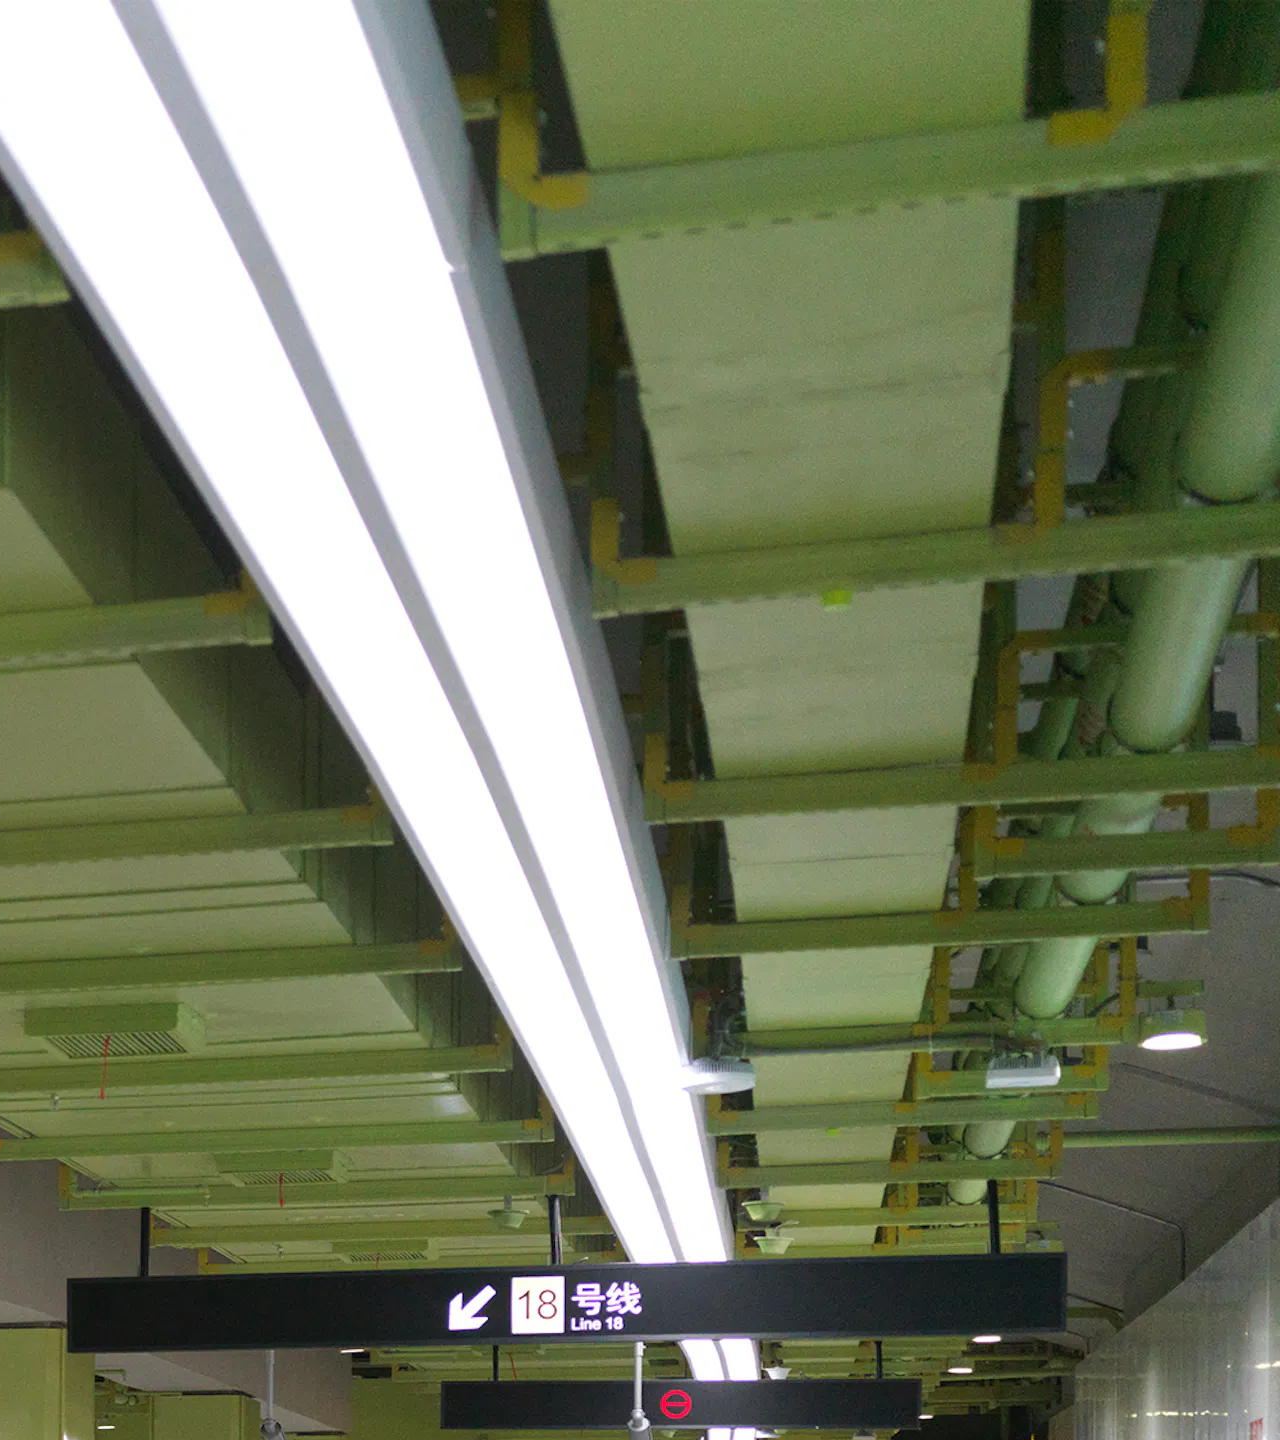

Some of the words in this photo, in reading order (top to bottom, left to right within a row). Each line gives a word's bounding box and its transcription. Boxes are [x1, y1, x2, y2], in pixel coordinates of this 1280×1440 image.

[518, 1289, 558, 1320] 18
[571, 1281, 642, 1317] 号线
[570, 1317, 602, 1331] Line
[605, 1316, 624, 1331] 18
